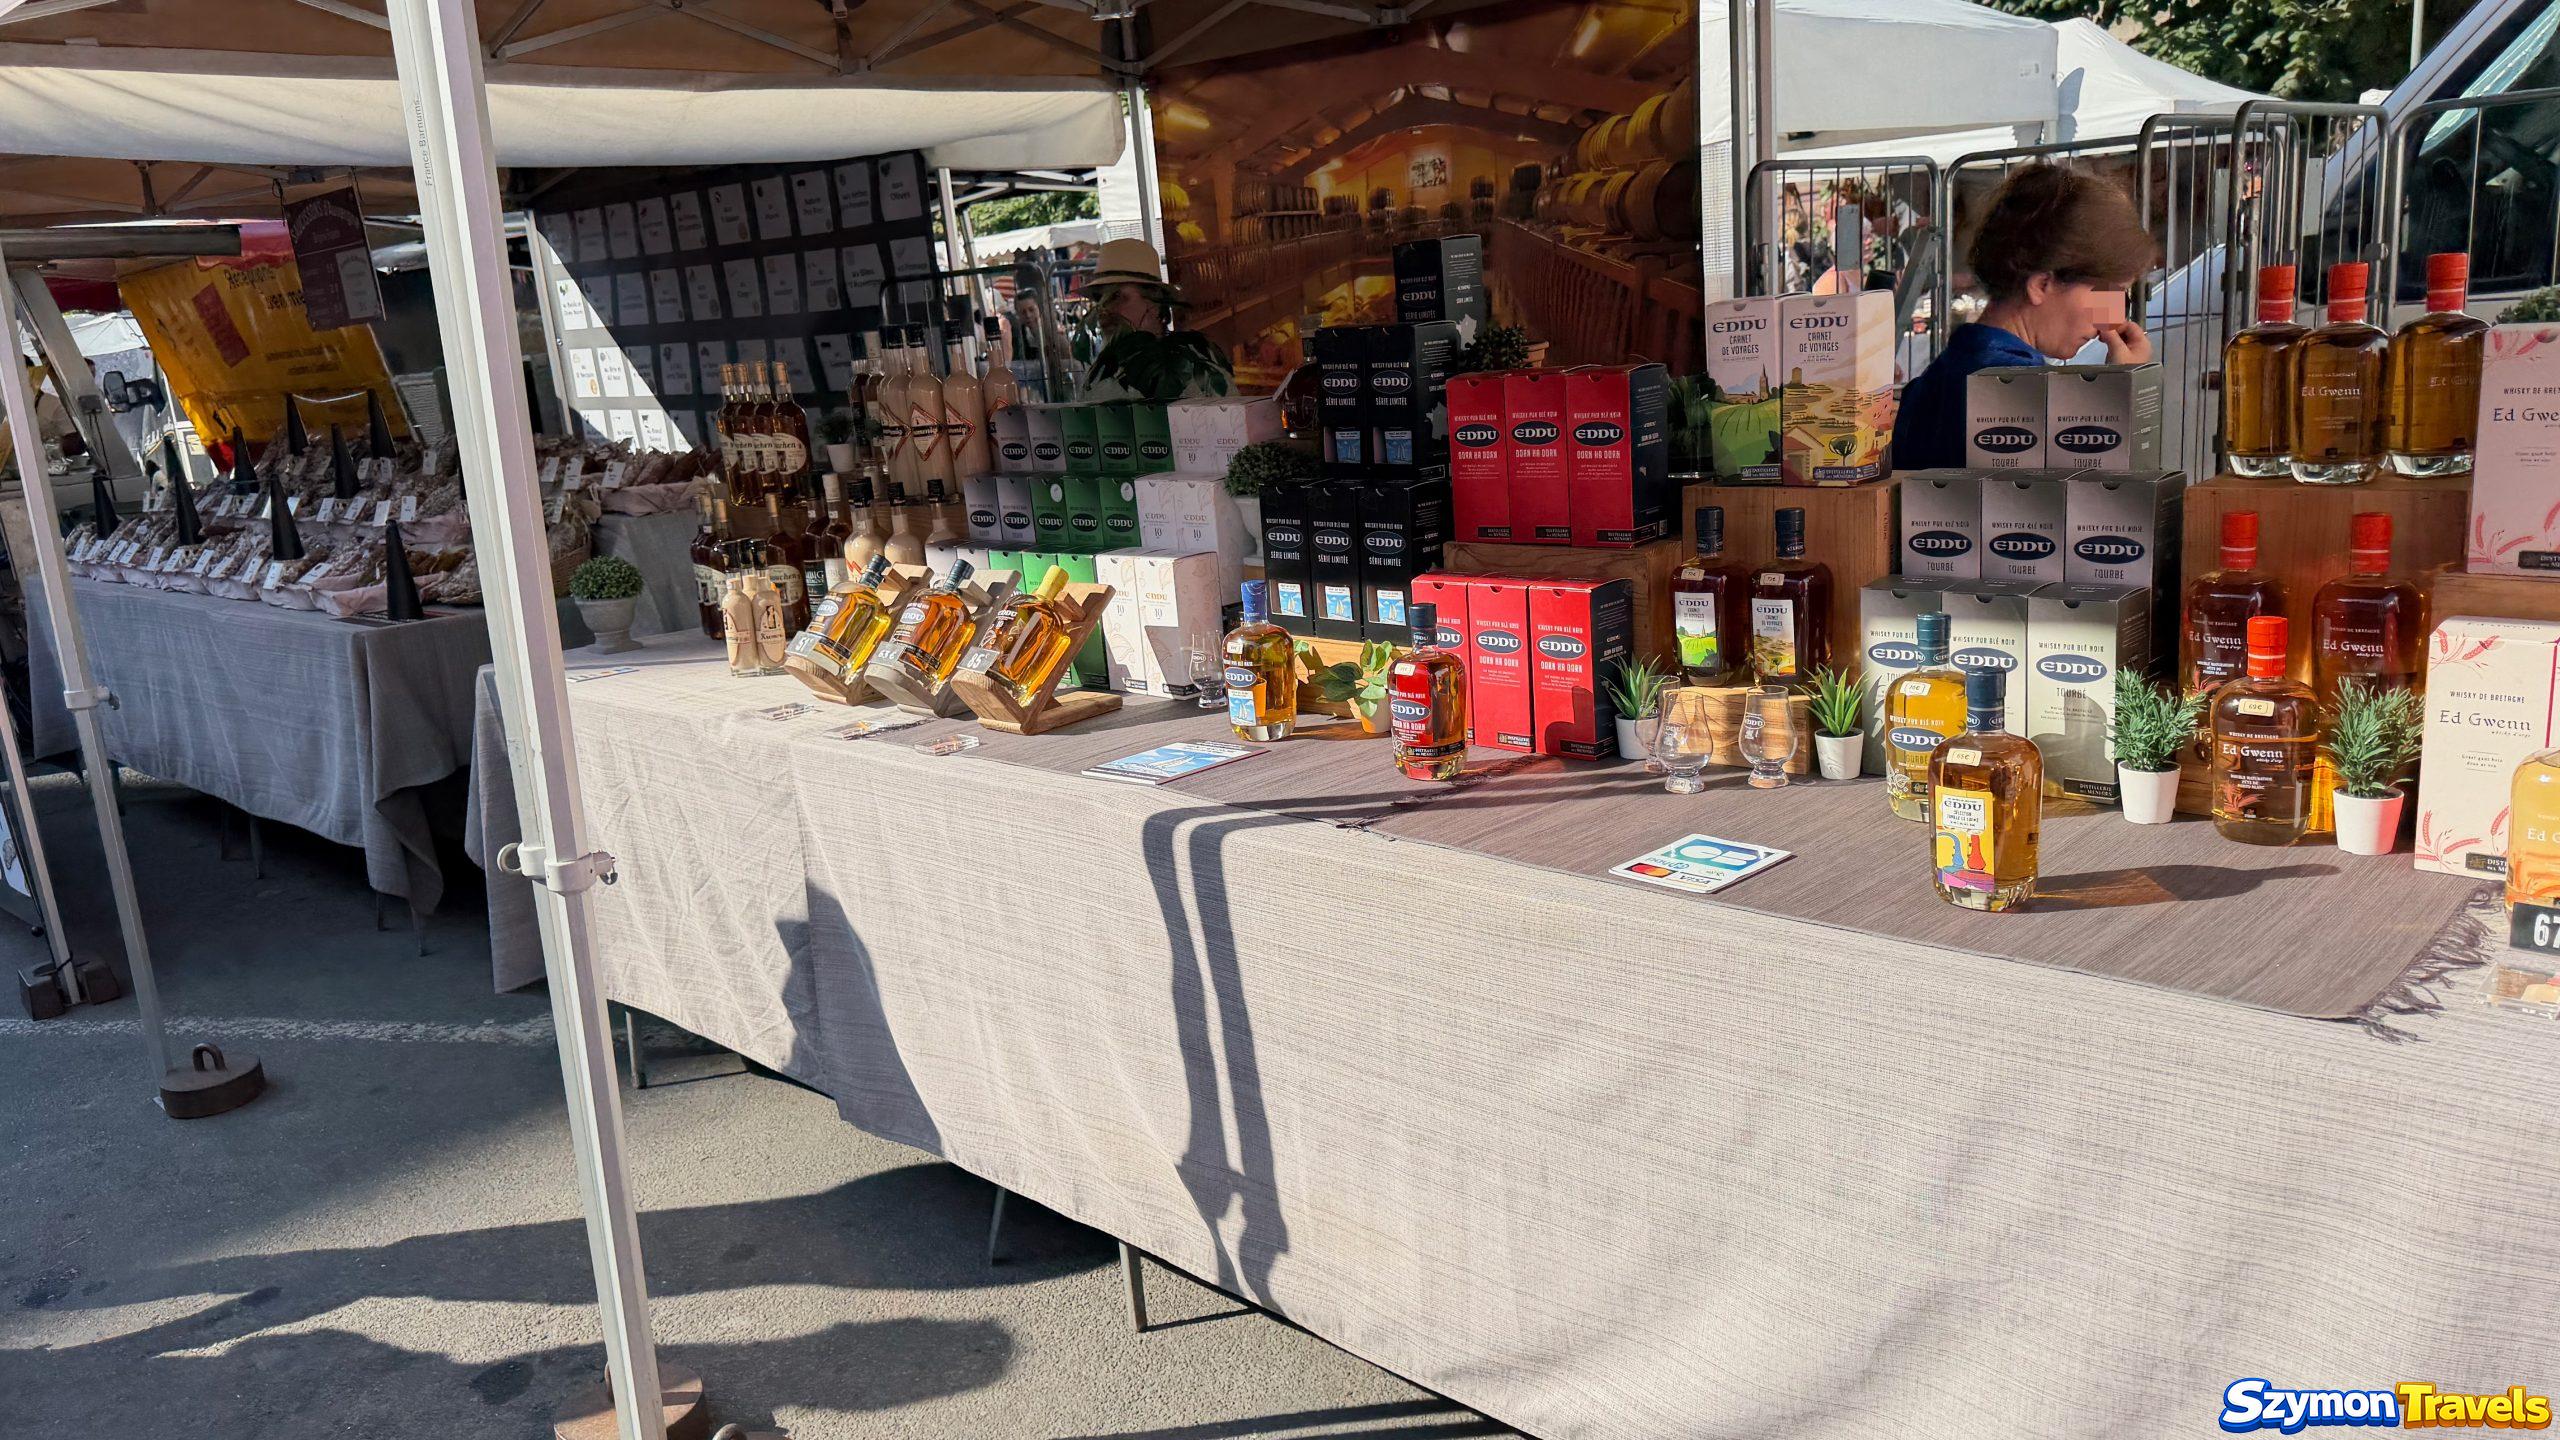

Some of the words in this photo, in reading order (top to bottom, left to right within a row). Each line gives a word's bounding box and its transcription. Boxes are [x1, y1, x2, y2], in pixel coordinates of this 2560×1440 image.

[1403, 291, 1436, 301] EDDU
[1713, 318, 1767, 333] EDDU
[1790, 315, 1848, 329] EDDU
[1730, 334, 1751, 344] CARNET
[1808, 332, 1832, 341] CARNET
[1722, 347, 1730, 355] DE
[1731, 344, 1759, 354] VOYAGES
[1800, 343, 1808, 353] DE
[1810, 342, 1839, 352] VOYAGES
[1324, 378, 1358, 387] EDDU
[1373, 377, 1409, 387] EDDU
[2302, 386, 2315, 397] Ed
[2319, 386, 2361, 396] Gwenn
[2504, 387, 2530, 395] WHISKY
[2010, 415, 2020, 423] BLÉ
[2493, 408, 2515, 421] Ed
[2522, 408, 2560, 421] Gwe
[1456, 430, 1497, 440] EDDU
[1514, 428, 1557, 438] EDDU
[1575, 429, 1620, 439] EDDU
[1978, 434, 2033, 445] EDDU
[2059, 434, 2116, 445] EDDU
[1104, 447, 1130, 456] EDDU
[1141, 446, 1168, 455] EDDU
[1992, 457, 2019, 467] TOURBÉ
[2073, 458, 2102, 468] TOURBÉ
[971, 515, 995, 523] EDDU
[1005, 516, 1029, 525] EDDU
[1038, 516, 1063, 526] EDDU
[1072, 518, 1097, 527] EDDU
[1107, 518, 1133, 528] EDDU
[2115, 525, 2126, 533] BLÉ
[1268, 532, 1301, 543] EDDU
[1315, 535, 1349, 546] EDDU
[1367, 538, 1403, 548] EDDU
[1913, 539, 1967, 550] EDDU
[1993, 540, 2052, 552] EDDU
[2079, 544, 2140, 556] EDDU
[1927, 561, 1954, 571] TOURBÉ
[2008, 563, 2036, 575] TOURBÉ
[2094, 568, 2124, 580] TOURBÉ
[1757, 606, 1788, 614] EDDU
[1870, 631, 1891, 639] WHISKY
[1892, 631, 1904, 639] PUR
[1905, 630, 1914, 640] BLÉ
[1953, 636, 1974, 644] WHISKY
[1990, 636, 2000, 645] BLÉ
[2189, 631, 2200, 641] Ed
[2203, 633, 2241, 645] Gwenn
[1478, 636, 1518, 647] EDDU
[1540, 641, 1582, 653] EDDU
[2038, 642, 2061, 650] WHISKY
[2063, 643, 2075, 651] PUR
[2077, 643, 2087, 652] BLÉ
[2323, 640, 2337, 650] Ed
[2341, 641, 2384, 652] Gwenn
[1953, 655, 2015, 668] EDDU
[2040, 662, 2103, 676] EDDU
[1226, 673, 1253, 682] EDDU
[2057, 687, 2087, 699] TOURBÉ
[2450, 691, 2476, 699] WHISKY
[2491, 694, 2525, 703] BRETAGNE
[1391, 704, 1426, 715] EDDU
[1889, 714, 1906, 724] WHISKY
[1919, 717, 1929, 726] BLÉ
[2439, 710, 2462, 725] Ed
[2469, 712, 2531, 731] Gwenn
[1891, 733, 1944, 747] EDDU
[2223, 744, 2236, 755] Ed
[2241, 746, 2283, 758] Gwenn
[1944, 800, 1982, 811] EDDU
[2527, 827, 2546, 842] Ed
[1679, 875, 1711, 884] VISA
